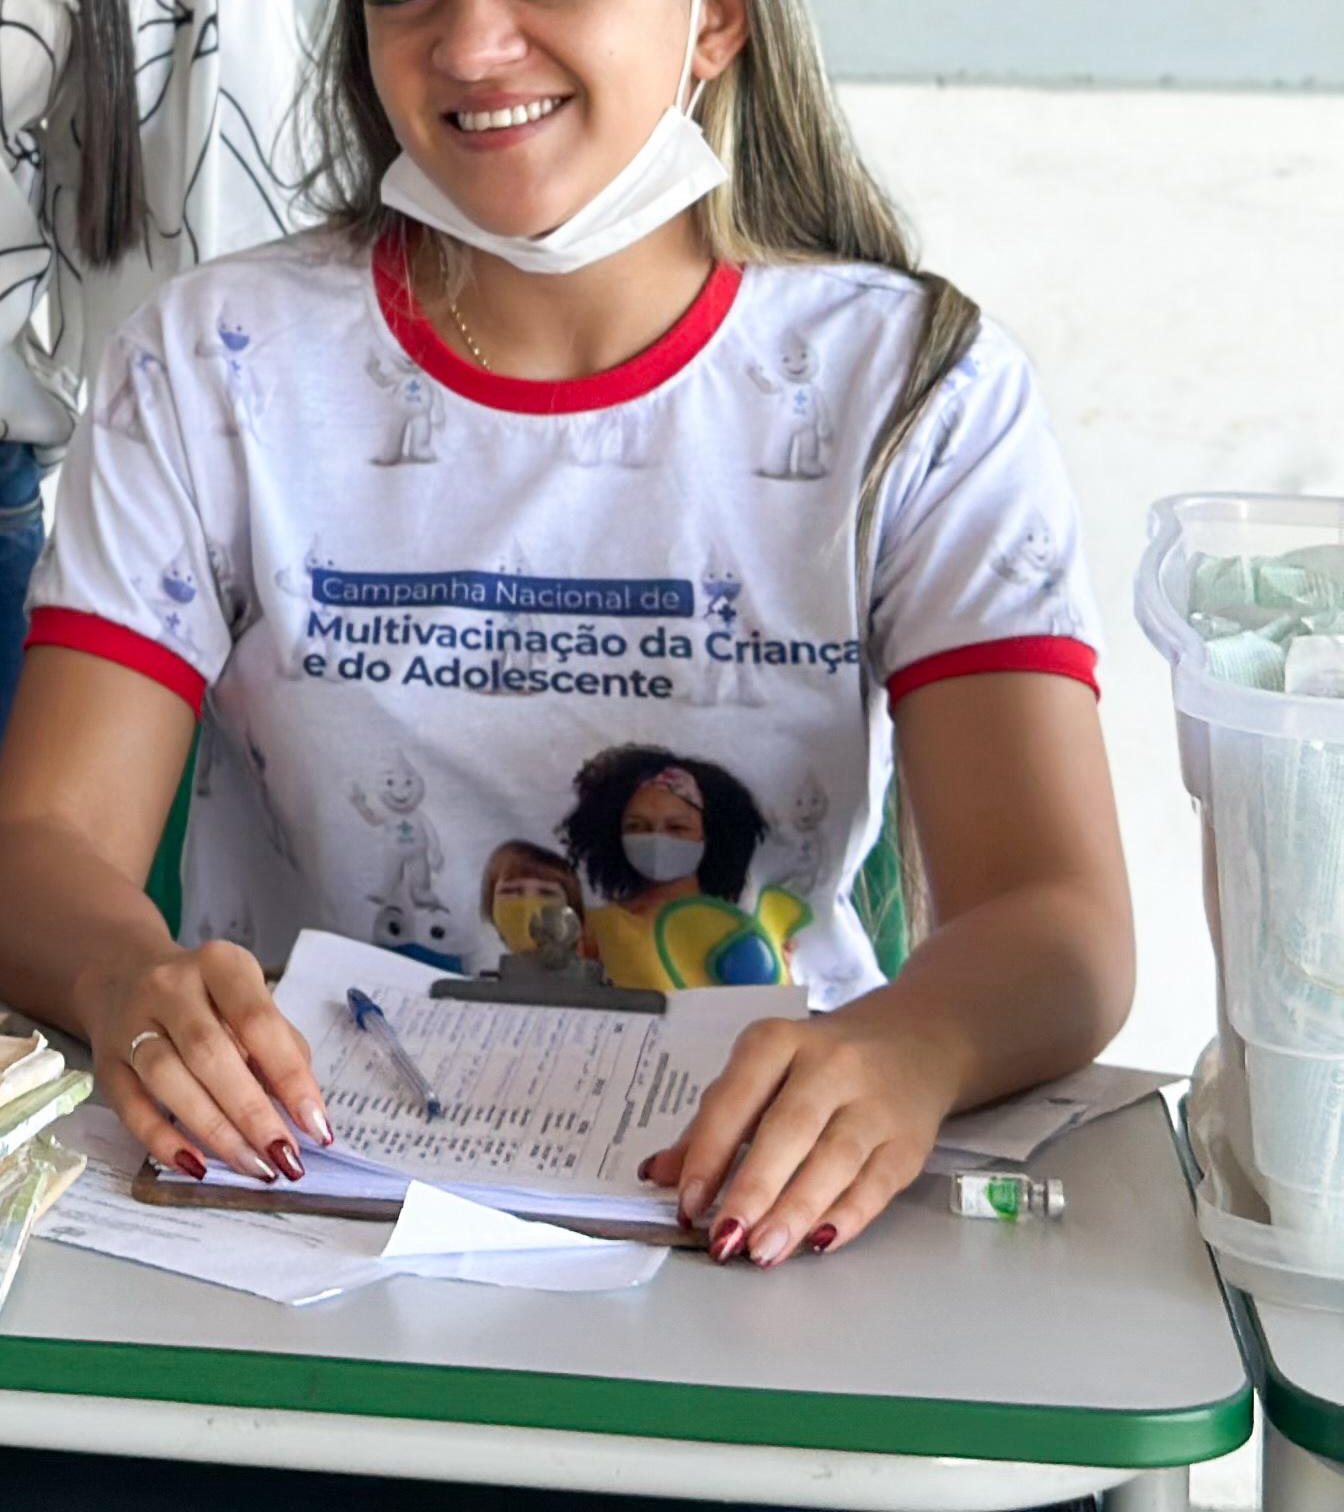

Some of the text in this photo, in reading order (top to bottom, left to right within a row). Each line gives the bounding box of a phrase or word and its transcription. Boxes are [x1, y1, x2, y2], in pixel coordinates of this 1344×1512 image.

[322, 577, 680, 611] Campanha Nacional de
[307, 610, 859, 674] Multivacinação da Criança
[303, 652, 673, 699] e do Adolescente
